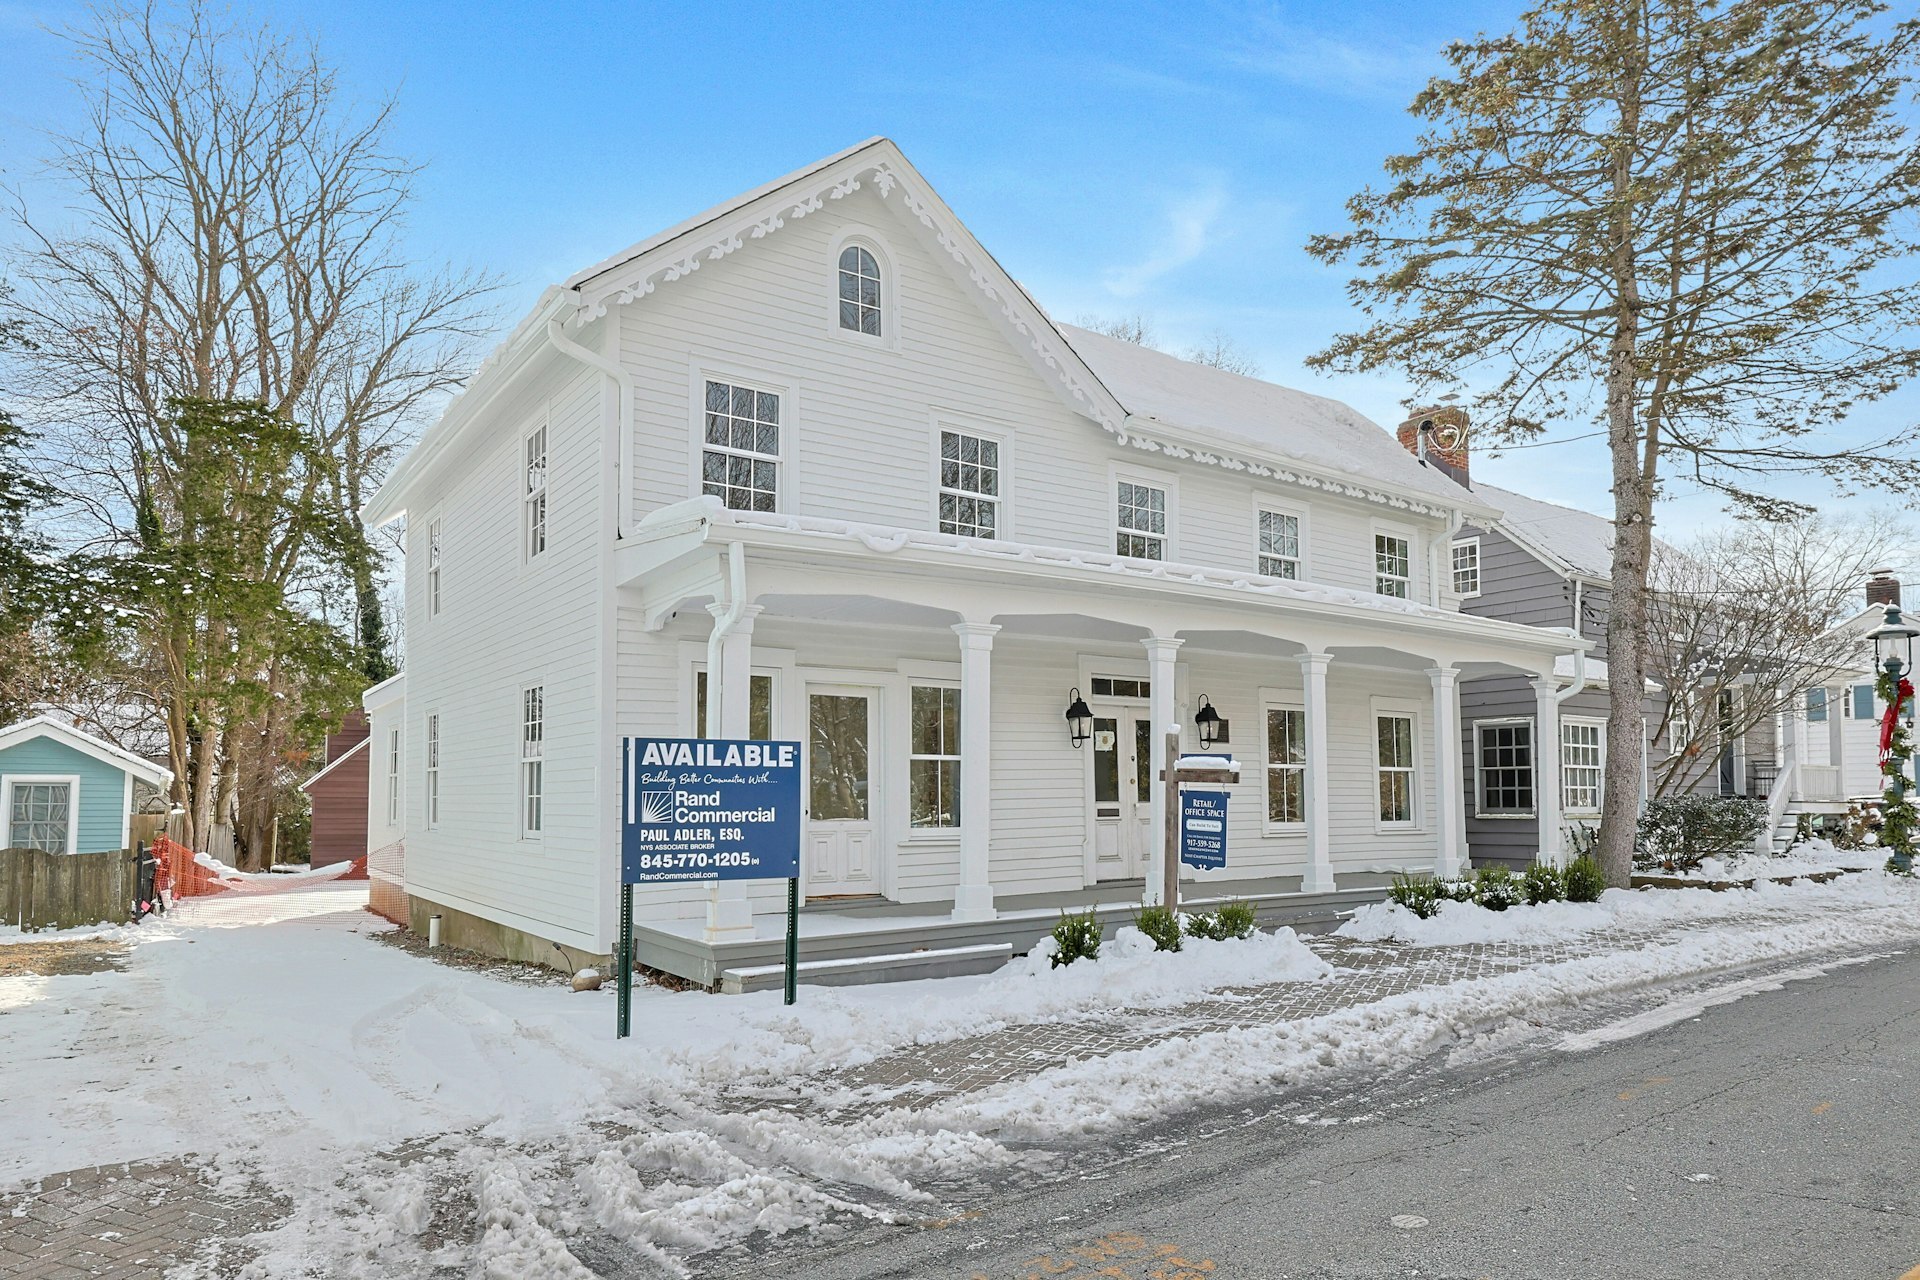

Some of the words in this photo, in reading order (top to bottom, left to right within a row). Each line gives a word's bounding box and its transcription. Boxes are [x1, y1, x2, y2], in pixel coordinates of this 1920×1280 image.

[642, 742, 794, 767] AVAILABLE
[641, 770, 676, 790] Building
[679, 773, 702, 784] Better
[704, 774, 746, 785] Communities
[675, 791, 720, 806] Rand
[675, 807, 775, 823] Commercial
[1185, 808, 1205, 816] OFFICE
[1207, 810, 1224, 818] SPACE
[640, 829, 670, 842] PAUL
[674, 828, 715, 842] ADLER,
[719, 828, 744, 841] ESQ.
[640, 852, 750, 869] 845-770-1205
[640, 872, 718, 880] RandCommercial.com
